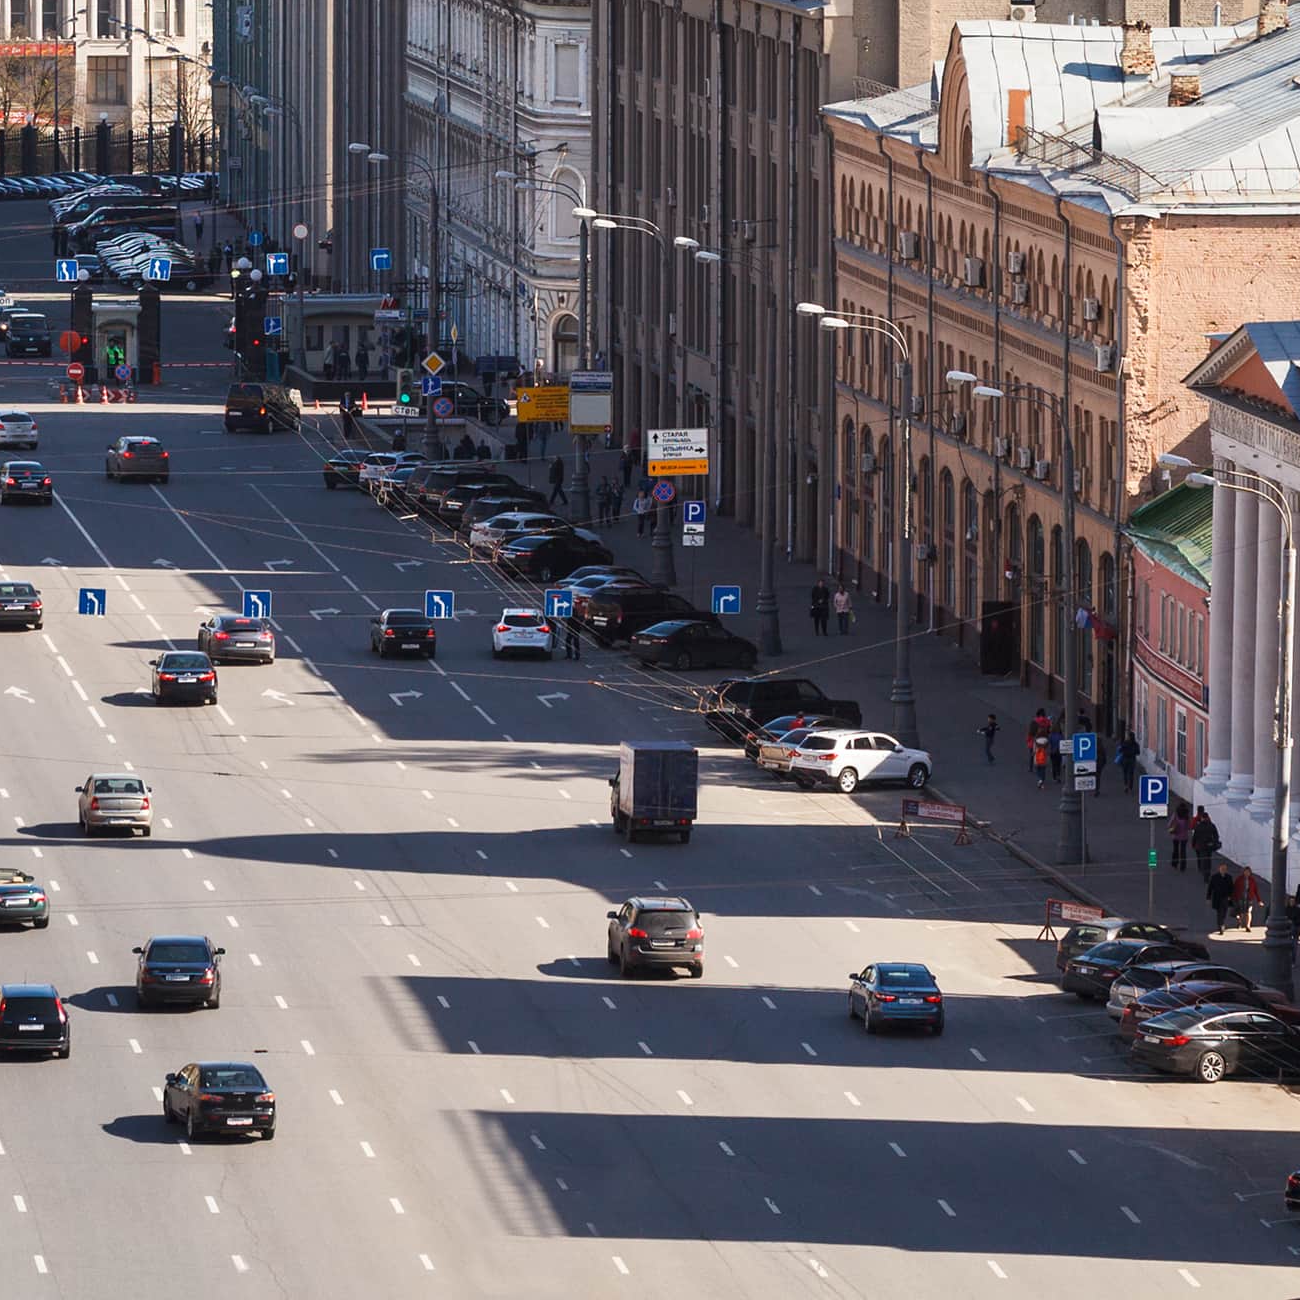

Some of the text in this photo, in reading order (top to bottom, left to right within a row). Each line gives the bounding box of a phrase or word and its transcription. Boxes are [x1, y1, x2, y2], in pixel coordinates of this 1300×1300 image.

[688, 503, 701, 521] P
[1079, 737, 1092, 758] P
[1147, 778, 1164, 802] P
